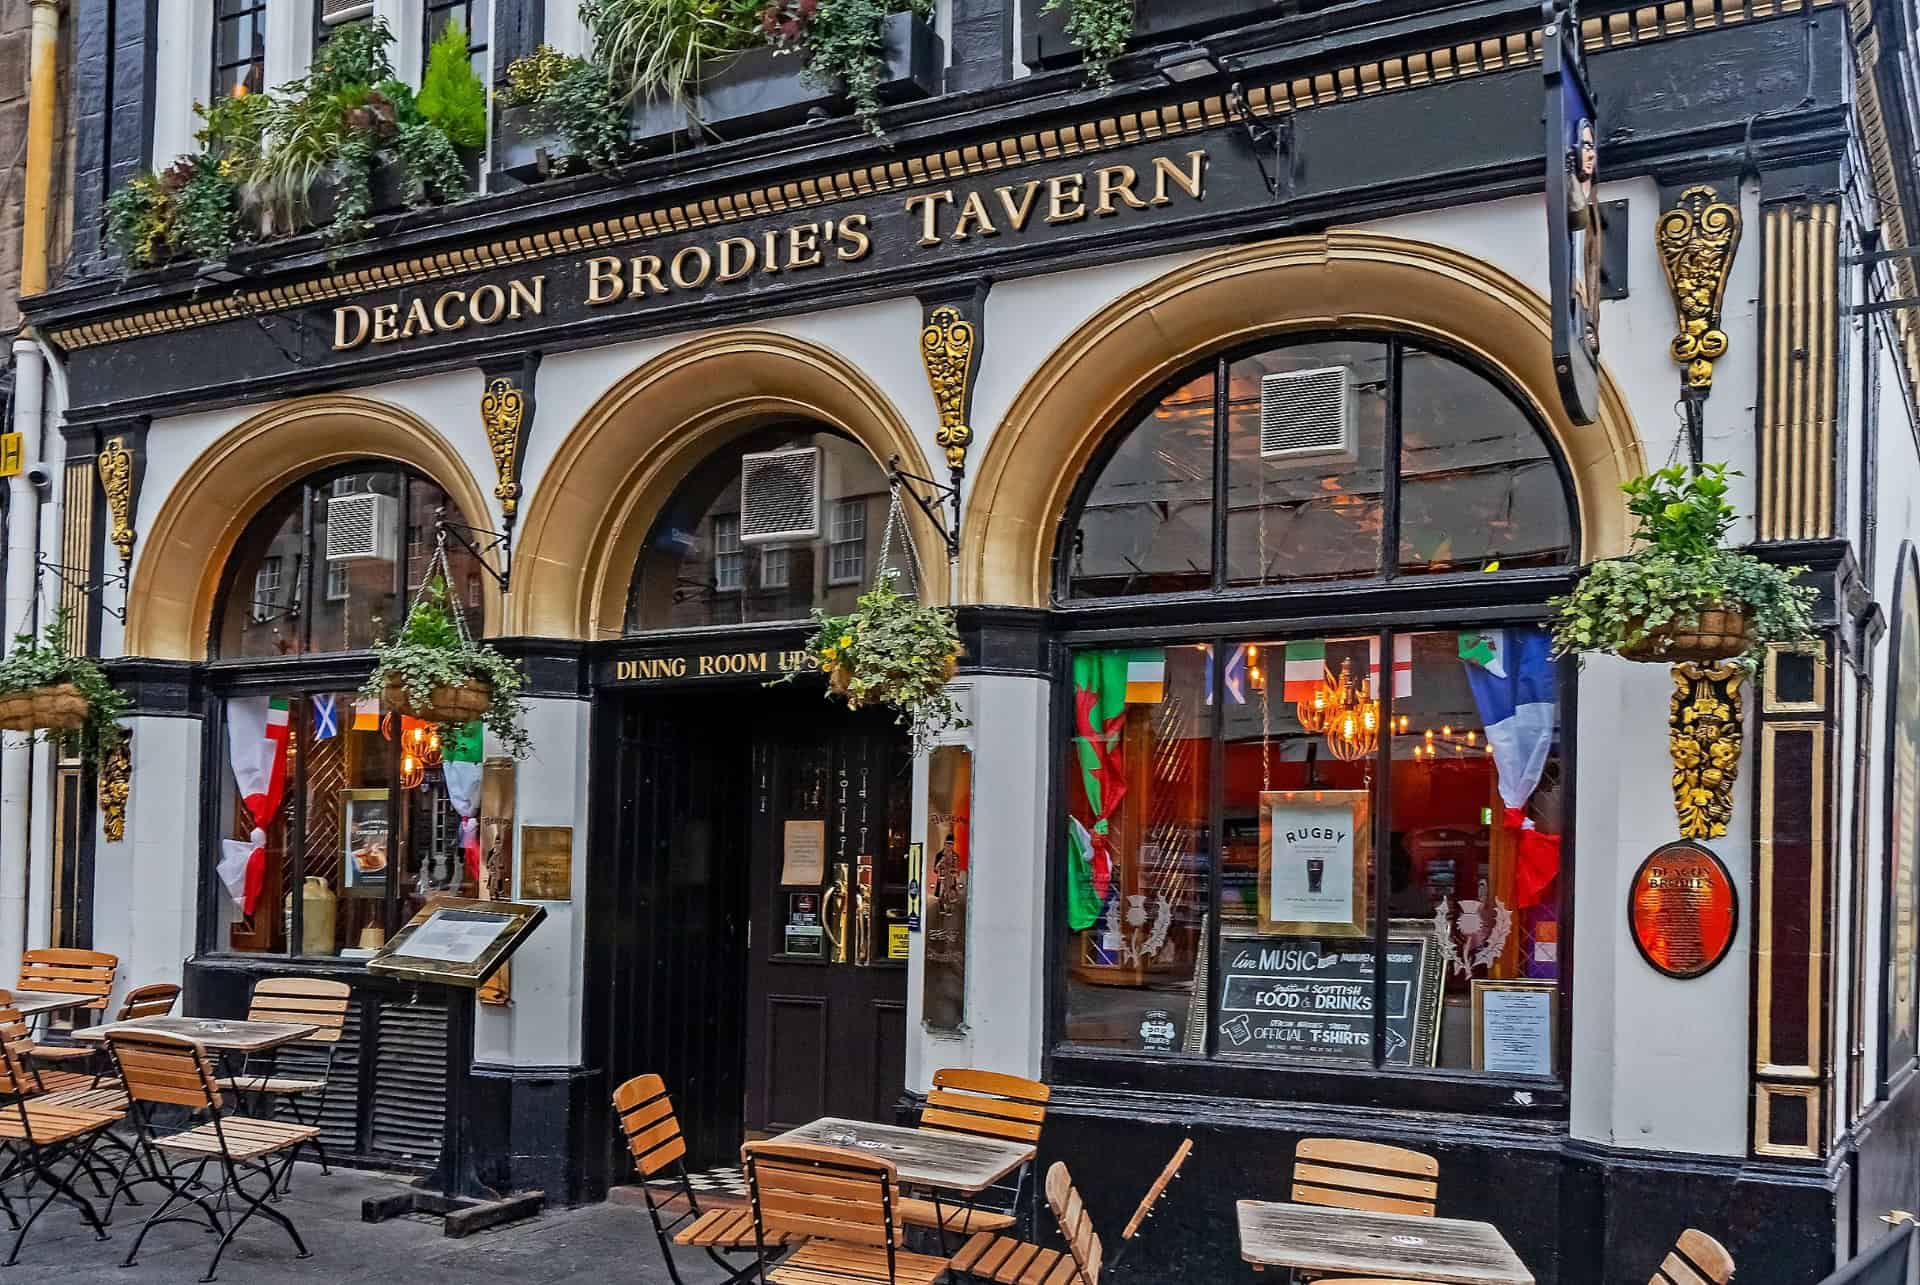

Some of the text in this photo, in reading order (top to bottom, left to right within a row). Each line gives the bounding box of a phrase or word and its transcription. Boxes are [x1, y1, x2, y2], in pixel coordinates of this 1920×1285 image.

[332, 150, 1210, 351] DEACON BRODIE'S TAVERN
[616, 657, 687, 681] DINING
[699, 652, 768, 676] ROOM
[1286, 827, 1346, 843] RUGBY
[1231, 950, 1257, 969] Live
[1258, 950, 1318, 972] MUSIC
[1311, 983, 1362, 996] SCOTTISH
[1255, 991, 1300, 1008] FOOD
[1314, 994, 1373, 1010] DRINKS
[1254, 1026, 1305, 1042] OFFICIAL
